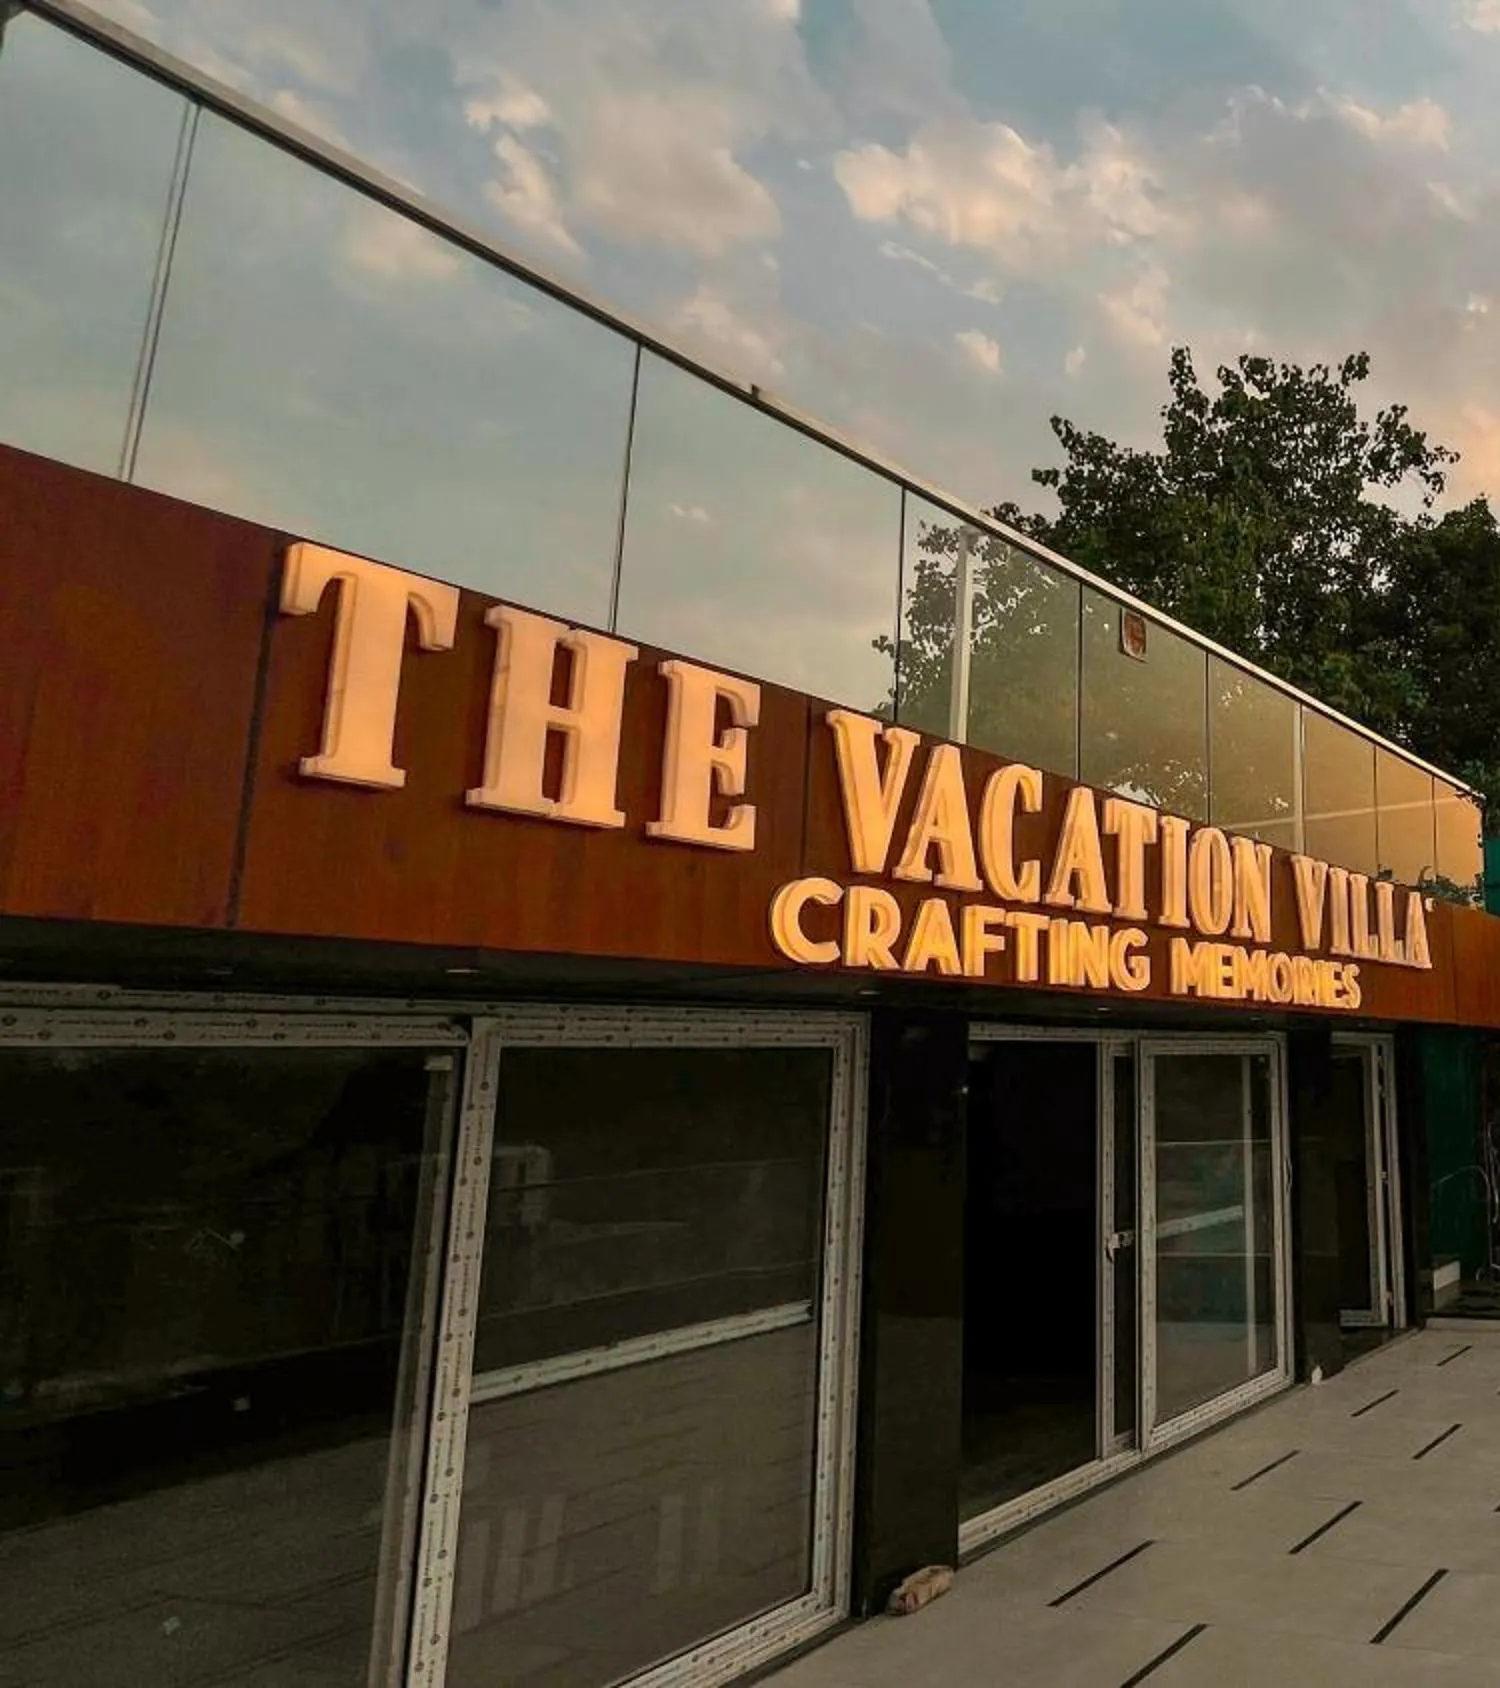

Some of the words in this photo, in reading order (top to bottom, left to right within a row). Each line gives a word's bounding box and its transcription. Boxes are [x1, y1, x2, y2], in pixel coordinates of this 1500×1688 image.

[279, 542, 761, 851] THE
[826, 709, 1273, 942] VACATION
[1290, 854, 1433, 969] VILLA
[770, 877, 1151, 991] CRAFTING
[1170, 937, 1361, 1009] MEMORIES
